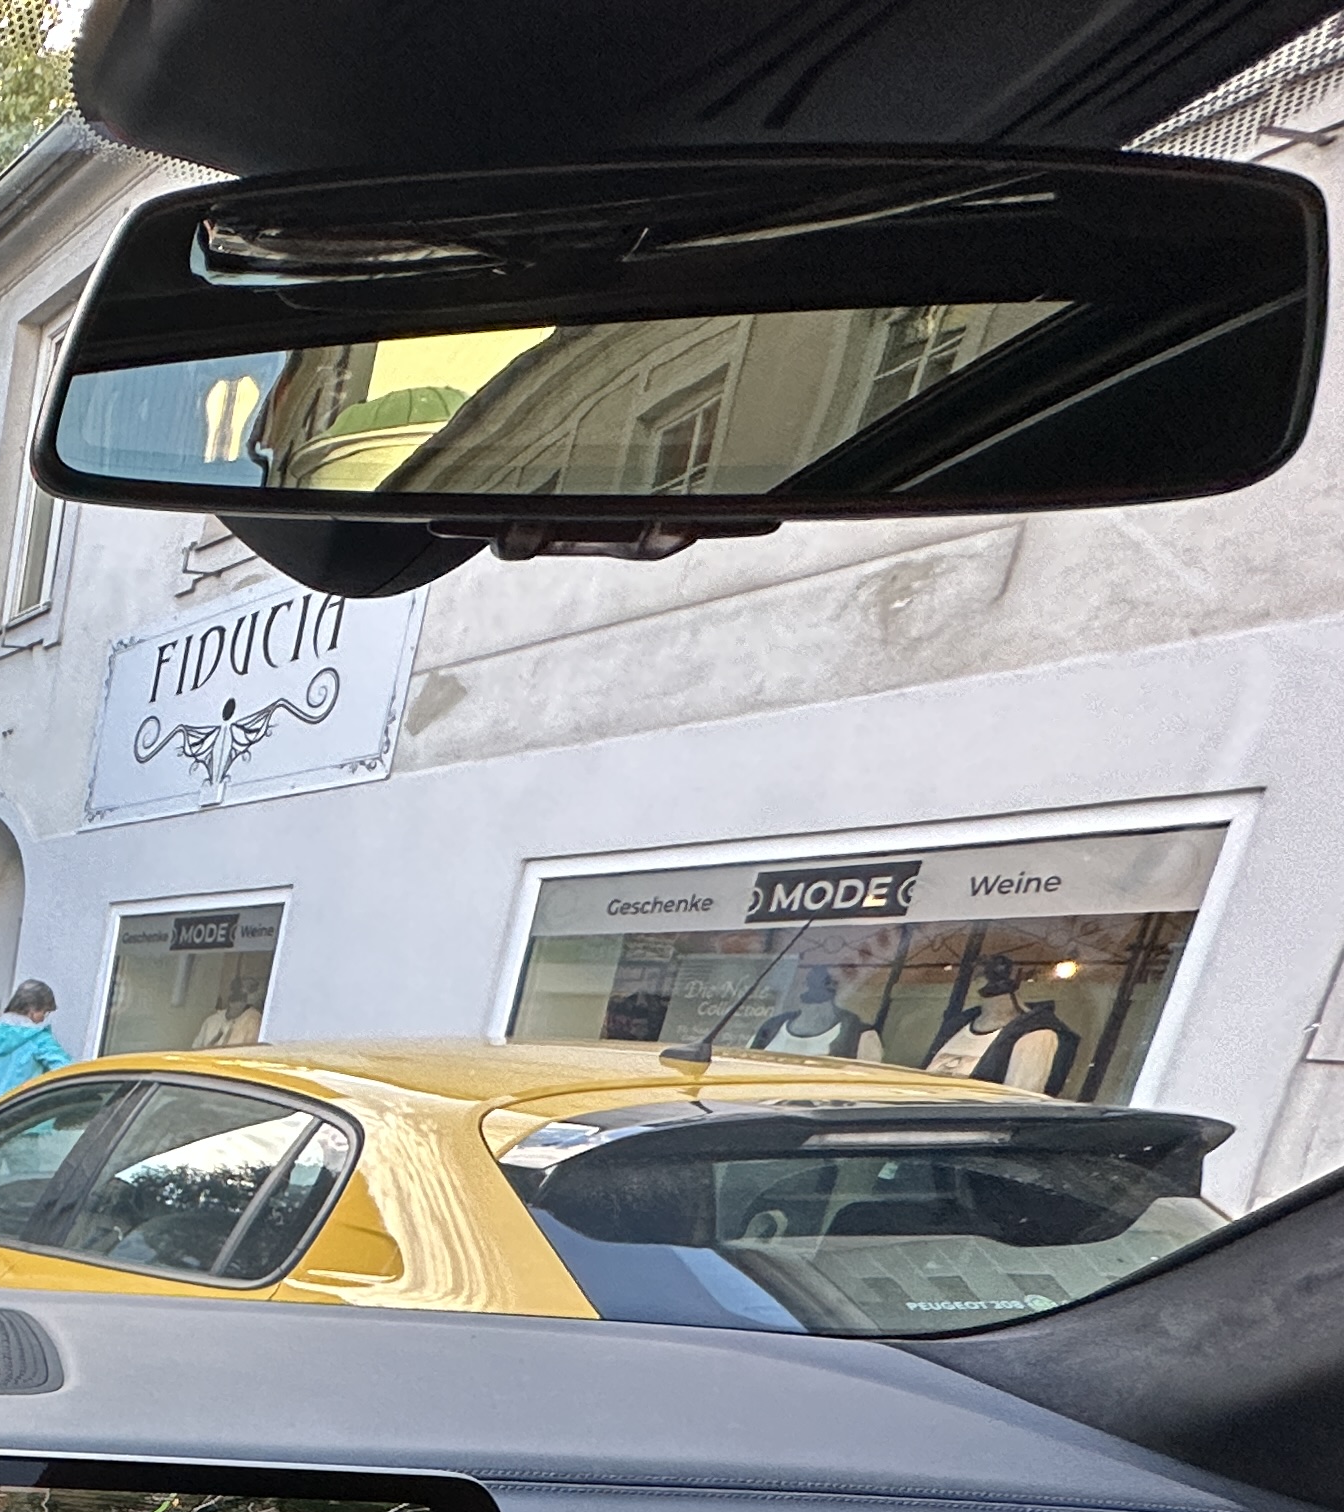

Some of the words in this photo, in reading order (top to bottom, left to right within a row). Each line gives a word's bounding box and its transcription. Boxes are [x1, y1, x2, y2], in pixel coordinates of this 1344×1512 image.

[149, 593, 346, 704] FIDUCIA
[606, 893, 715, 917] Geschenke
[768, 875, 894, 913] MODE
[968, 870, 1063, 898] Weine
[179, 922, 229, 944] MODE
[240, 924, 275, 938] Weine
[905, 1300, 988, 1311] PEUGEOT
